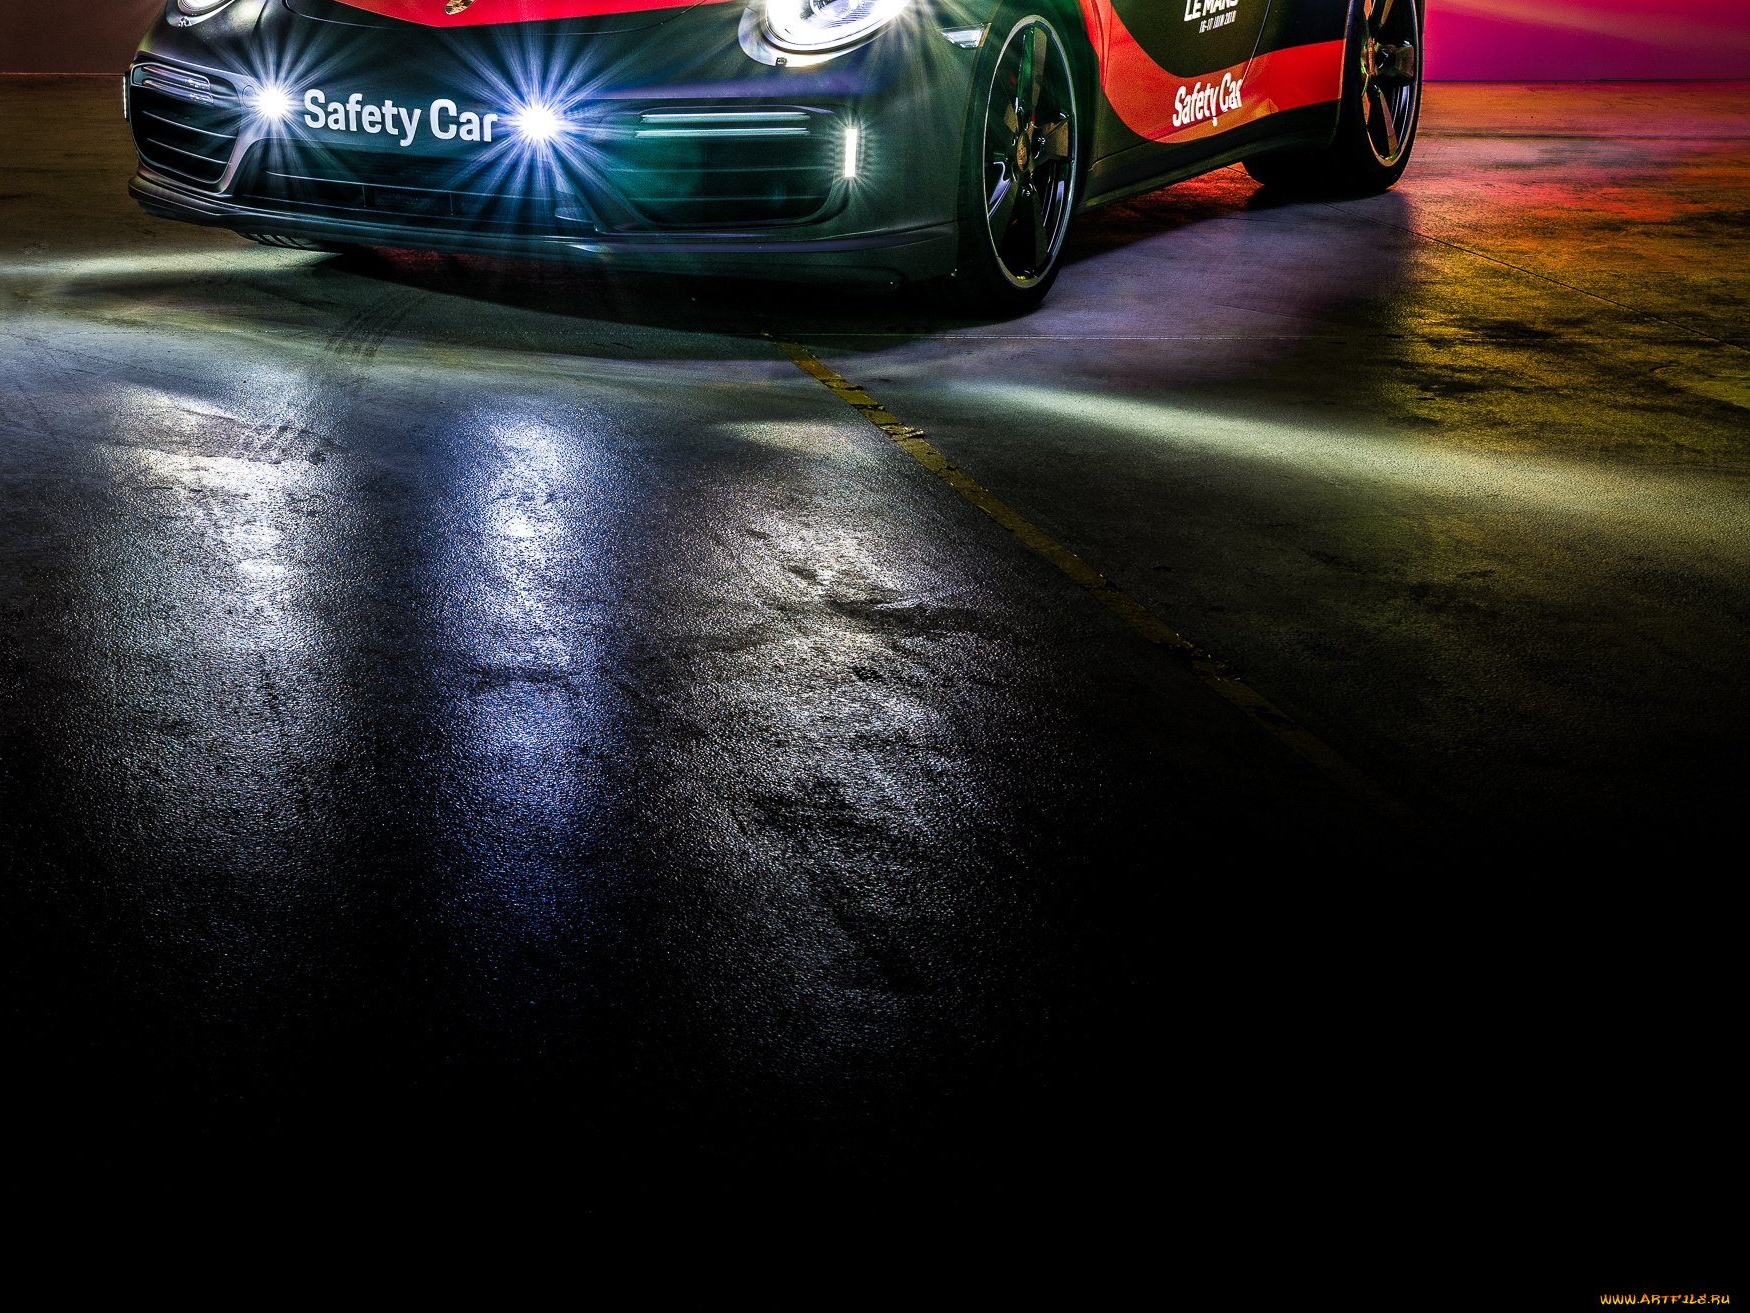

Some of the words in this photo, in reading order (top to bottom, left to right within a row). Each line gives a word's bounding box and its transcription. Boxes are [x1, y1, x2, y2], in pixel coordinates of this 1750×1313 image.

[303, 89, 421, 147] Safety
[429, 98, 499, 143] Car
[1172, 80, 1221, 127] Safety
[1219, 71, 1244, 112] Car
